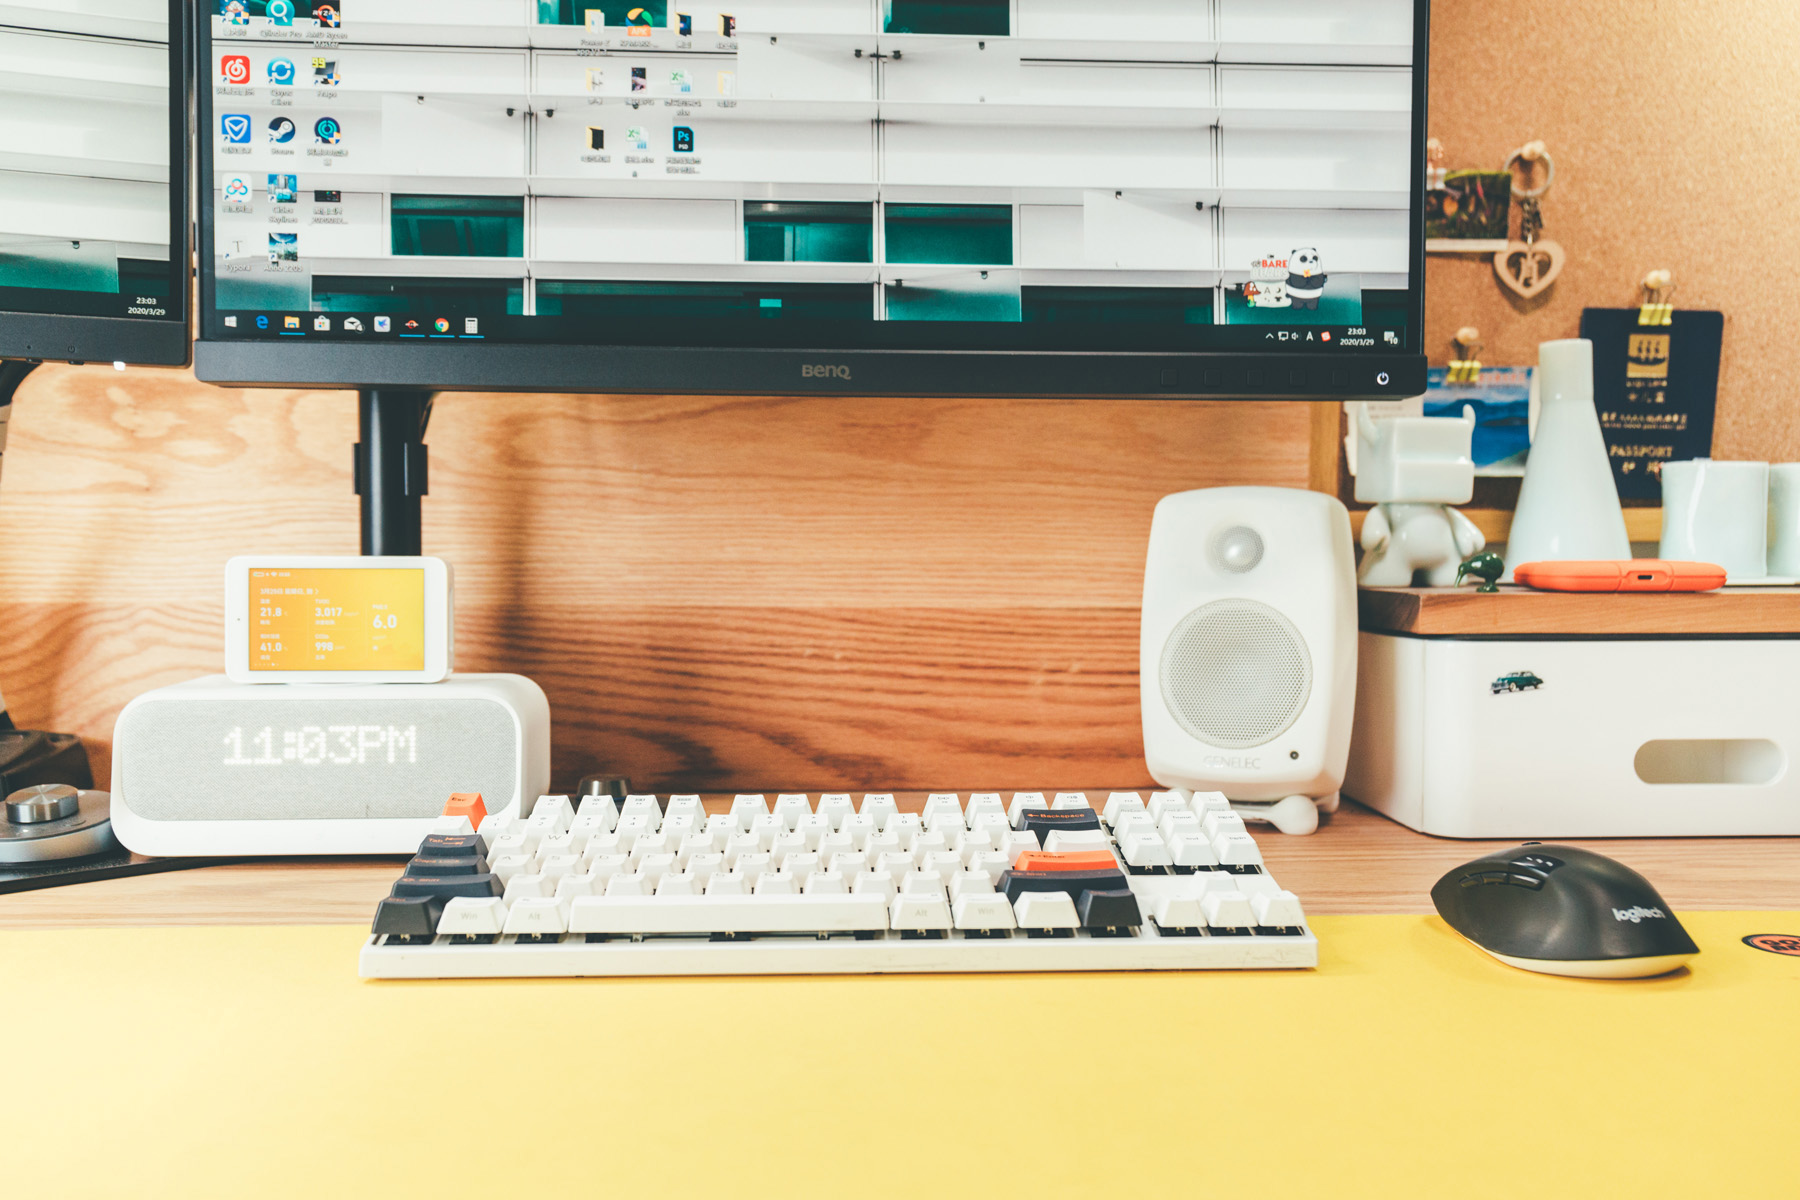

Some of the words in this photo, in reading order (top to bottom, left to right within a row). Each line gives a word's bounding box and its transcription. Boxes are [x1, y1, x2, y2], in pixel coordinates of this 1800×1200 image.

[312, 58, 325, 68] 99
[677, 131, 690, 142] Ps
[1261, 259, 1288, 269] BARE
[128, 307, 165, 316] 2020/3/29
[1306, 331, 1314, 341] A
[1389, 336, 1398, 344] 10
[1340, 338, 1375, 346] 2020/3/29
[802, 364, 851, 380] BenQ
[260, 607, 282, 617] 21.8
[315, 607, 342, 617] 3.017
[373, 614, 397, 629] 6.0
[260, 642, 282, 652] 41.0
[315, 642, 334, 652] 998
[223, 725, 417, 765] 11:03PM
[1612, 905, 1666, 924] logitech
